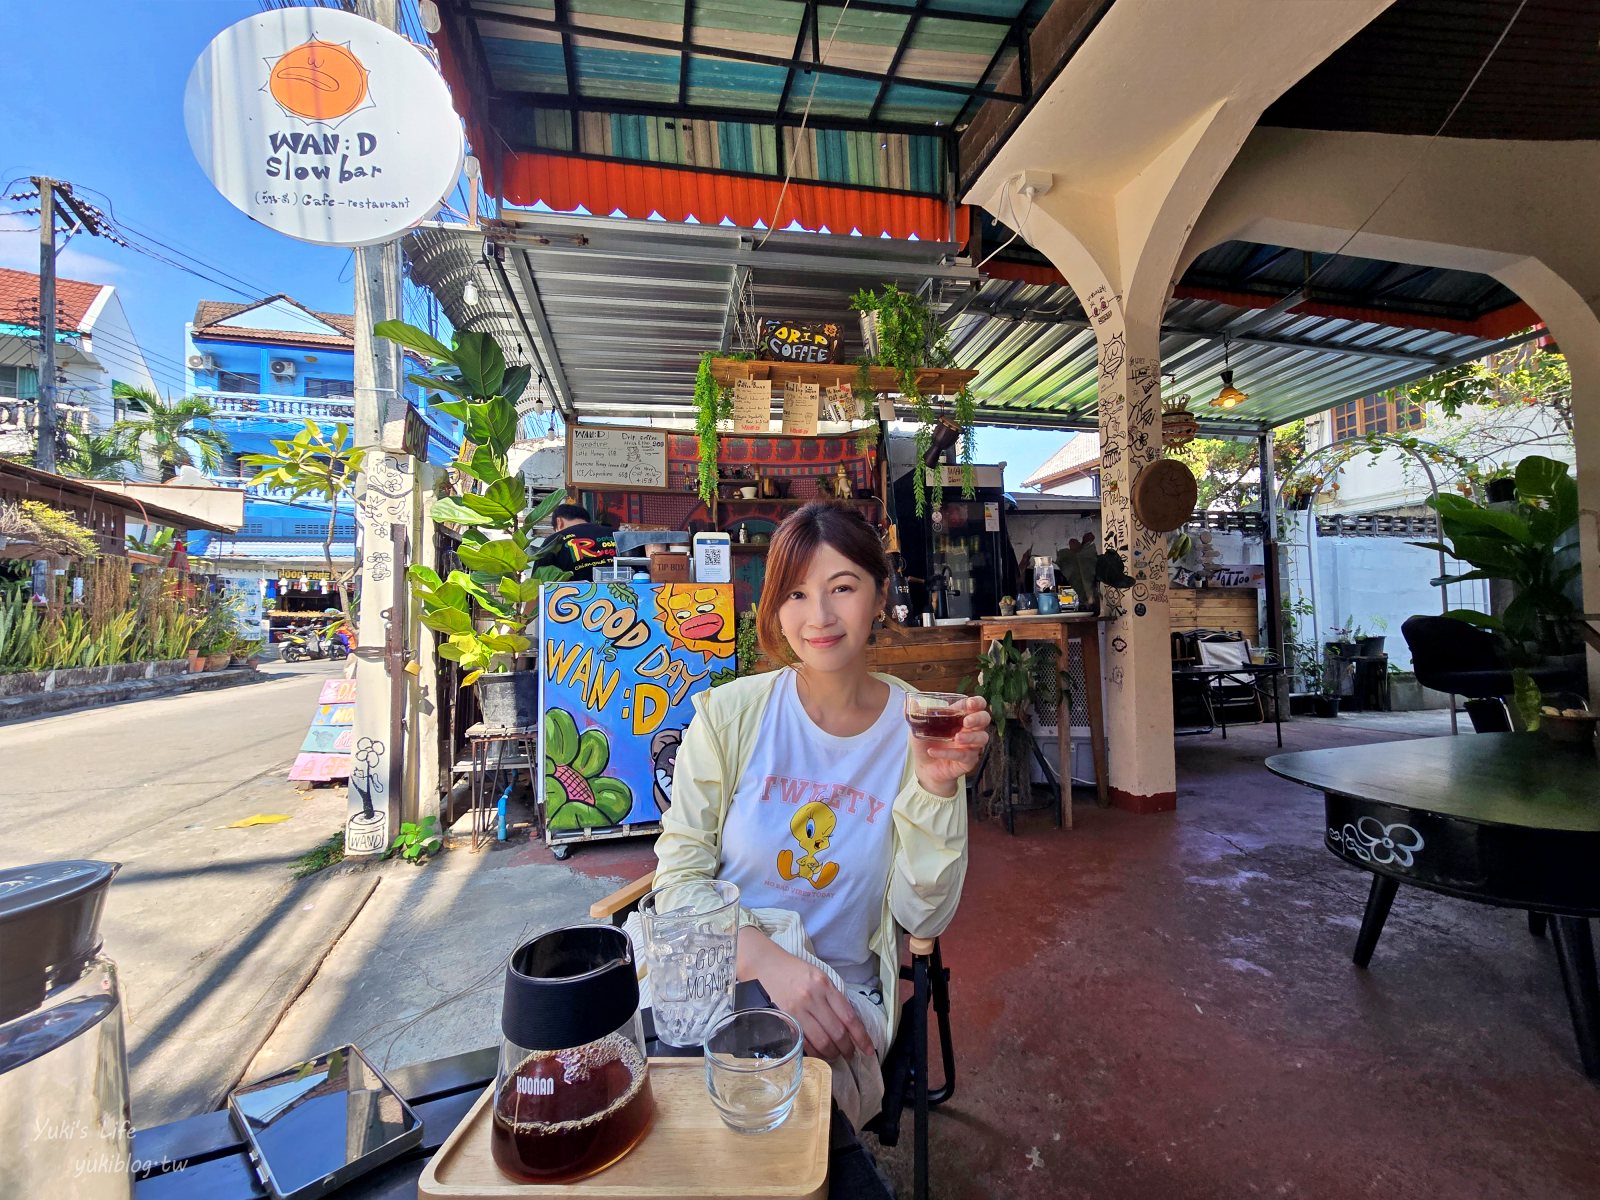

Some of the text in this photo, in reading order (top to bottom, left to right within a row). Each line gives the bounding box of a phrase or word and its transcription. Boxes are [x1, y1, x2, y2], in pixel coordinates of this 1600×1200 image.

[265, 151, 382, 184] Slow bar
[774, 326, 828, 345] DRIP
[769, 337, 829, 362] COFFEE
[306, 572, 330, 580] FREE
[657, 563, 685, 571] TIP BOX
[547, 586, 650, 649] GOOD
[634, 643, 709, 706] DAY
[761, 775, 886, 824] TWEETY
[776, 882, 790, 890] BAD
[516, 1075, 554, 1095] KOONAN
